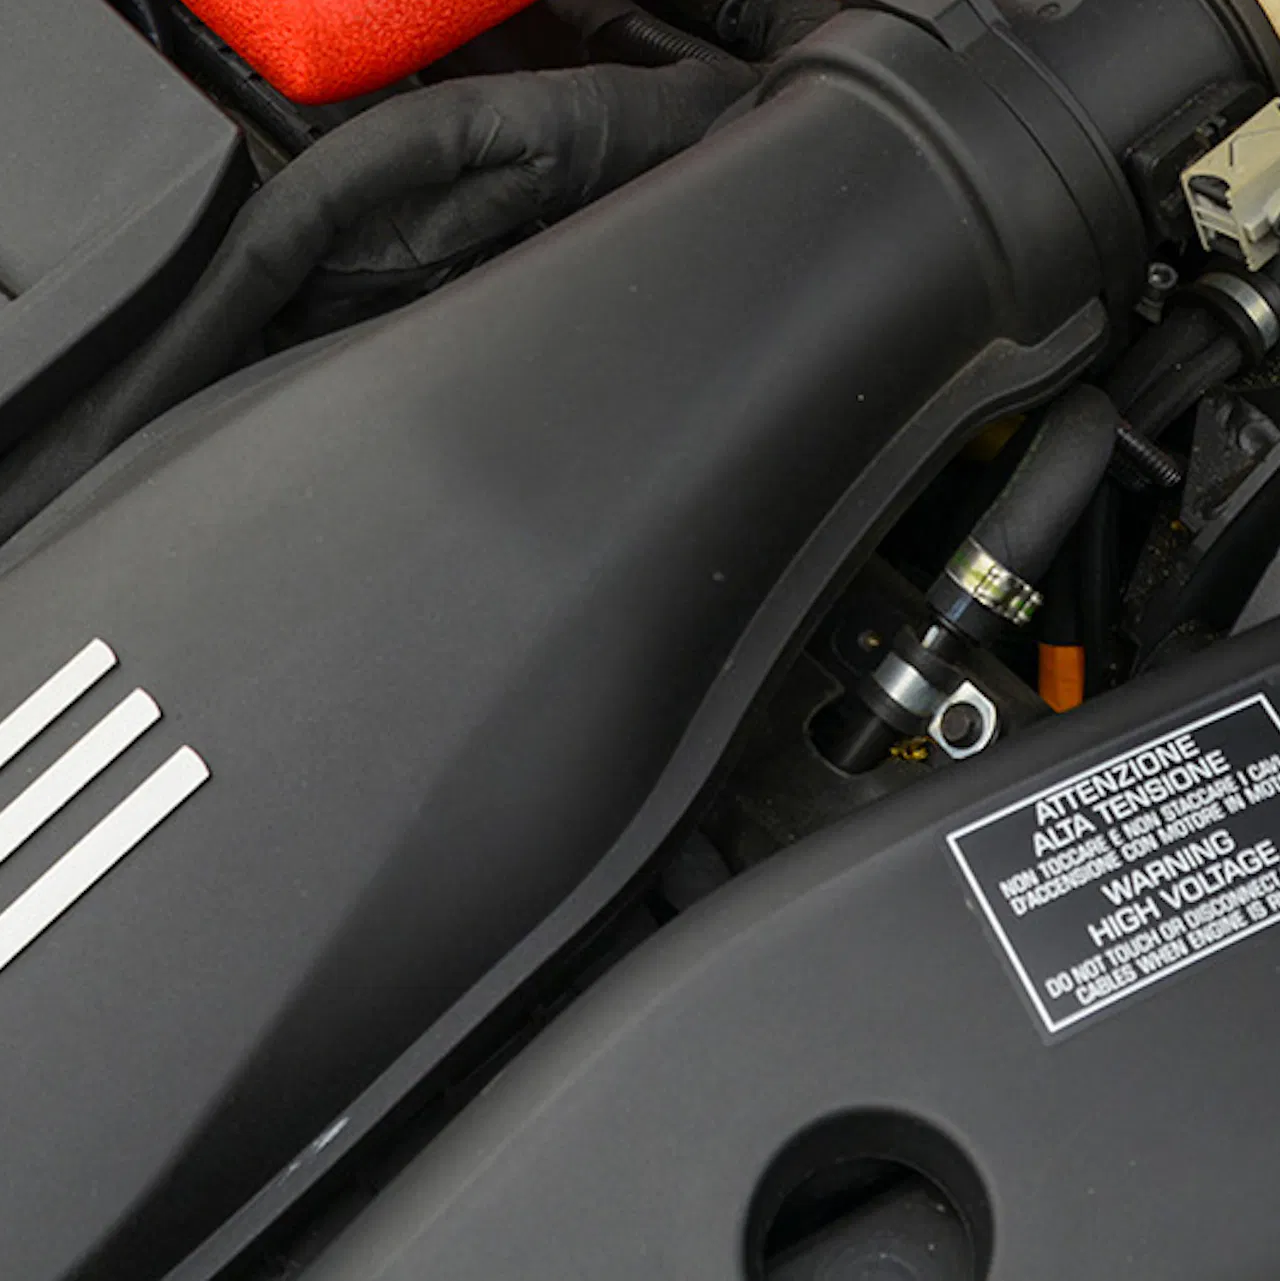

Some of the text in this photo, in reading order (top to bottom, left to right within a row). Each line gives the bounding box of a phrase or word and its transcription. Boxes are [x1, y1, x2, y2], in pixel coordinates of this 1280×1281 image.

[1033, 749, 1231, 858] ALTA TENSIONE
[1035, 734, 1200, 826] ATTENZIONE
[998, 868, 1040, 900] NON
[1037, 834, 1111, 879] TOCCARE
[1107, 828, 1127, 847] E
[1121, 810, 1162, 841] NON
[1159, 775, 1239, 822] STACCARE
[1009, 850, 1123, 916] D'ACCENSIONE
[1120, 833, 1159, 862] CON
[1156, 802, 1226, 845] MOTORE
[1223, 793, 1246, 814] IN
[1100, 829, 1236, 906] WARNING
[1087, 839, 1280, 947] HIGH VOLTAGE
[1044, 971, 1075, 999] DO
[1070, 954, 1107, 985] NOT
[1103, 928, 1162, 968] TOUCH
[1158, 916, 1187, 942] OR
[1074, 962, 1138, 1006] CABLES
[1135, 937, 1189, 975] WHEN
[1186, 909, 1249, 950] ENGINE
[1245, 900, 1268, 921] IS
